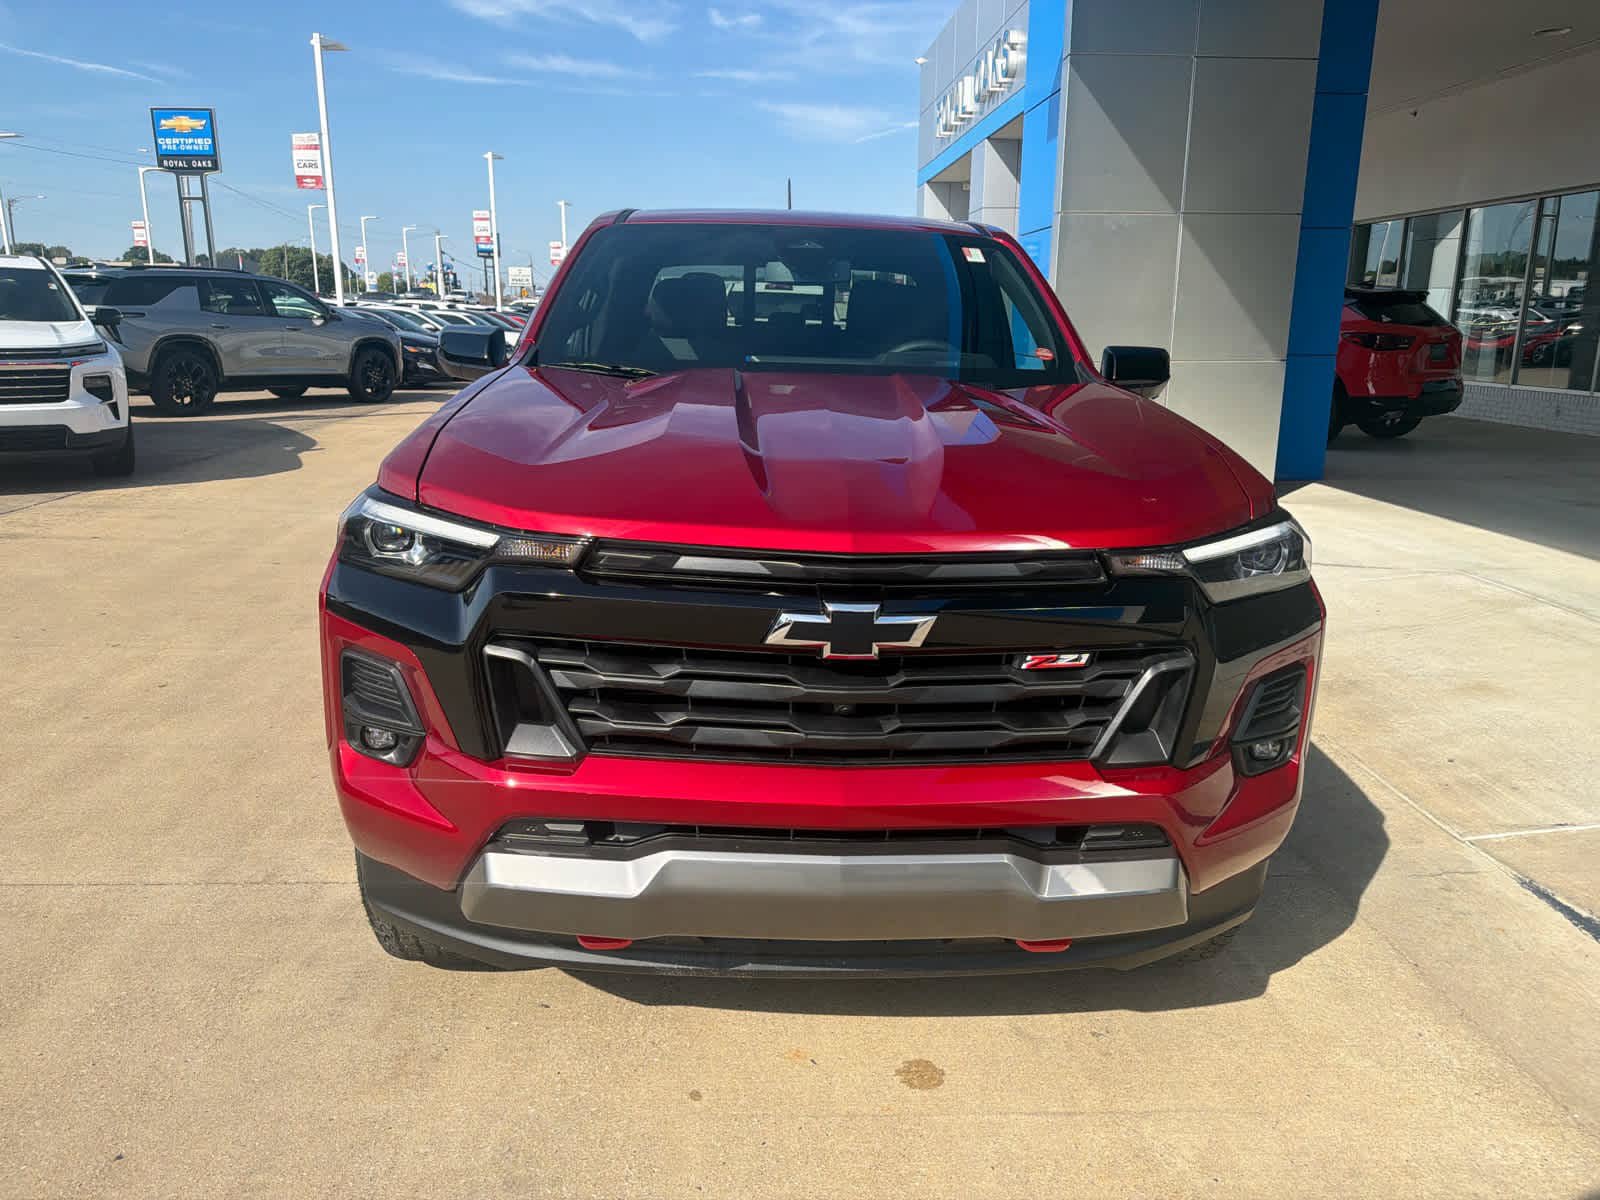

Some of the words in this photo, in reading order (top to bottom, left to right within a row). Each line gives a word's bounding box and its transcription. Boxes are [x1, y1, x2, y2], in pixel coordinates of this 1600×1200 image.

[158, 137, 212, 145] CERTIFIED
[163, 159, 189, 167] ROYAL
[191, 159, 212, 168] OAKS
[1020, 653, 1090, 669] Z71
